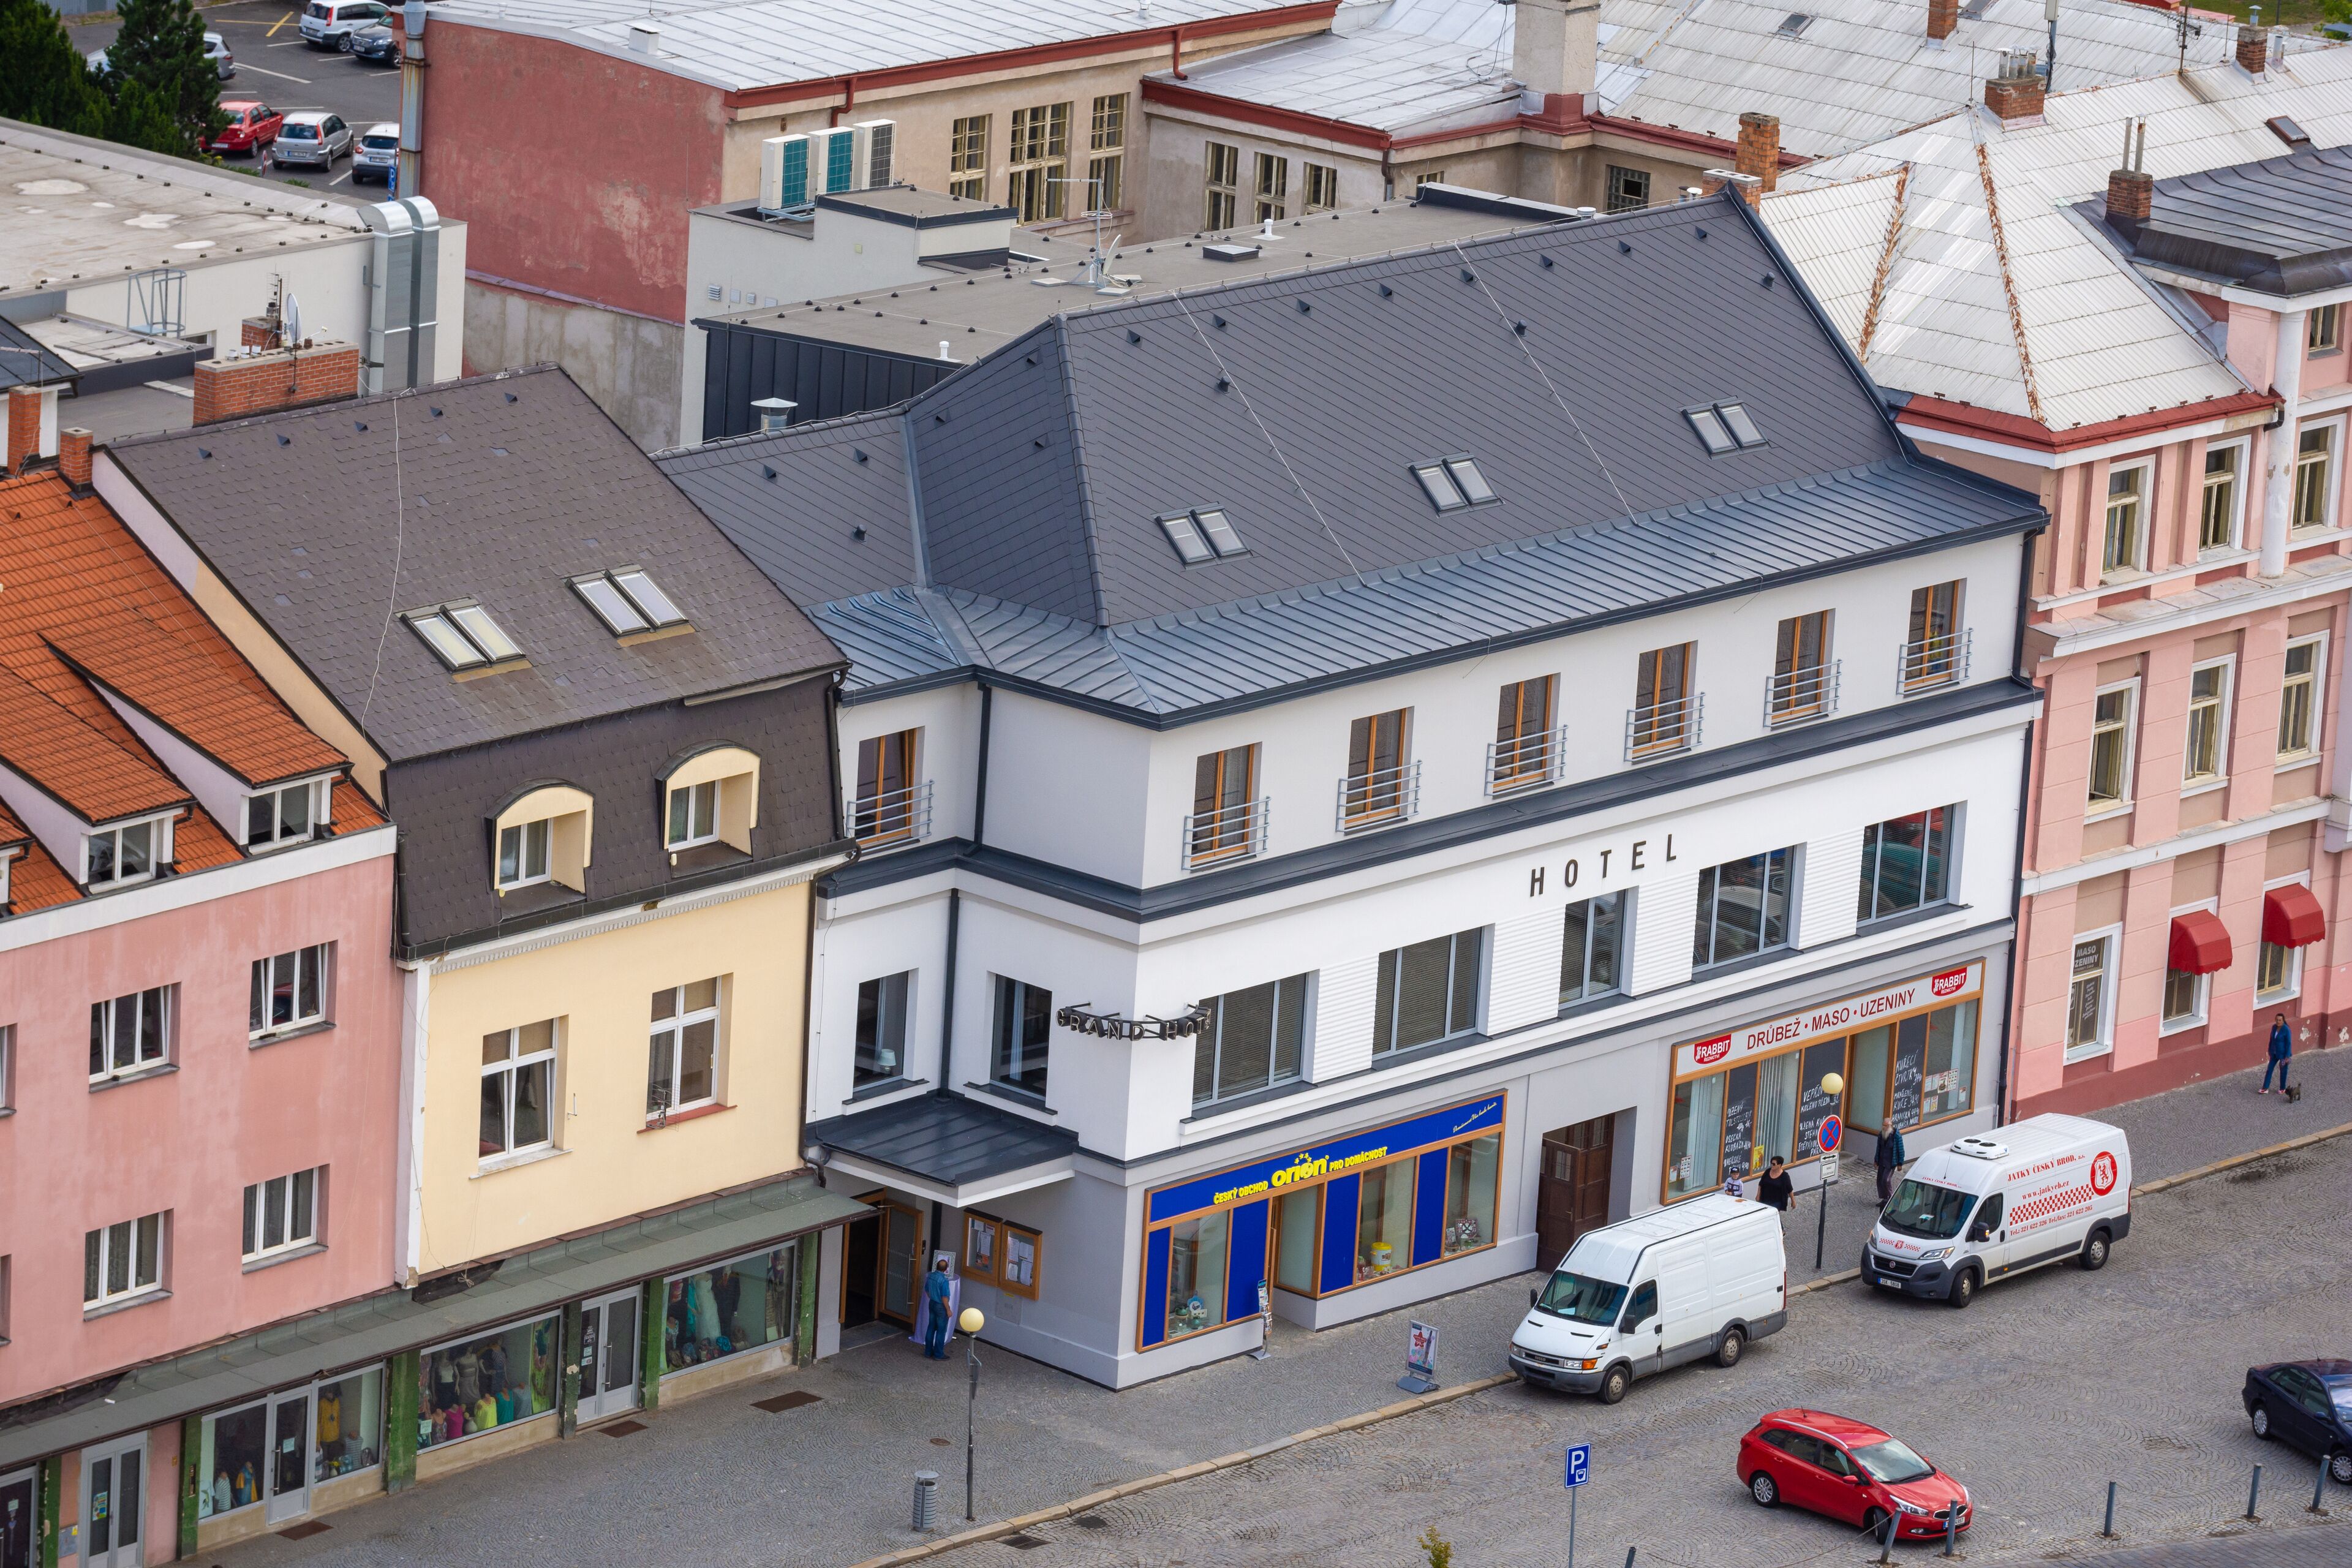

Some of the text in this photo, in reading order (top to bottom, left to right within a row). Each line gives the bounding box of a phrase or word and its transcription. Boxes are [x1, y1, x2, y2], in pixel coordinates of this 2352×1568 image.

[1530, 834, 1676, 897] HOTEL
[2074, 954, 2098, 968] ZENINY
[2076, 945, 2096, 957] MASO
[1939, 973, 1966, 990] RABBIT
[1056, 1009, 1145, 1041] GRAND
[1747, 988, 1915, 1050] DRŮBEŽ MASO UZENINY
[1701, 1040, 1730, 1058] RABBIT
[1213, 1146, 1388, 1204] ČESKÝ OBCHOD orion PRO DOMÁCNOST
[2008, 1168, 2030, 1182] JATKY
[2032, 1158, 2055, 1174] ČESKÝ
[1570, 1450, 1585, 1474] P
